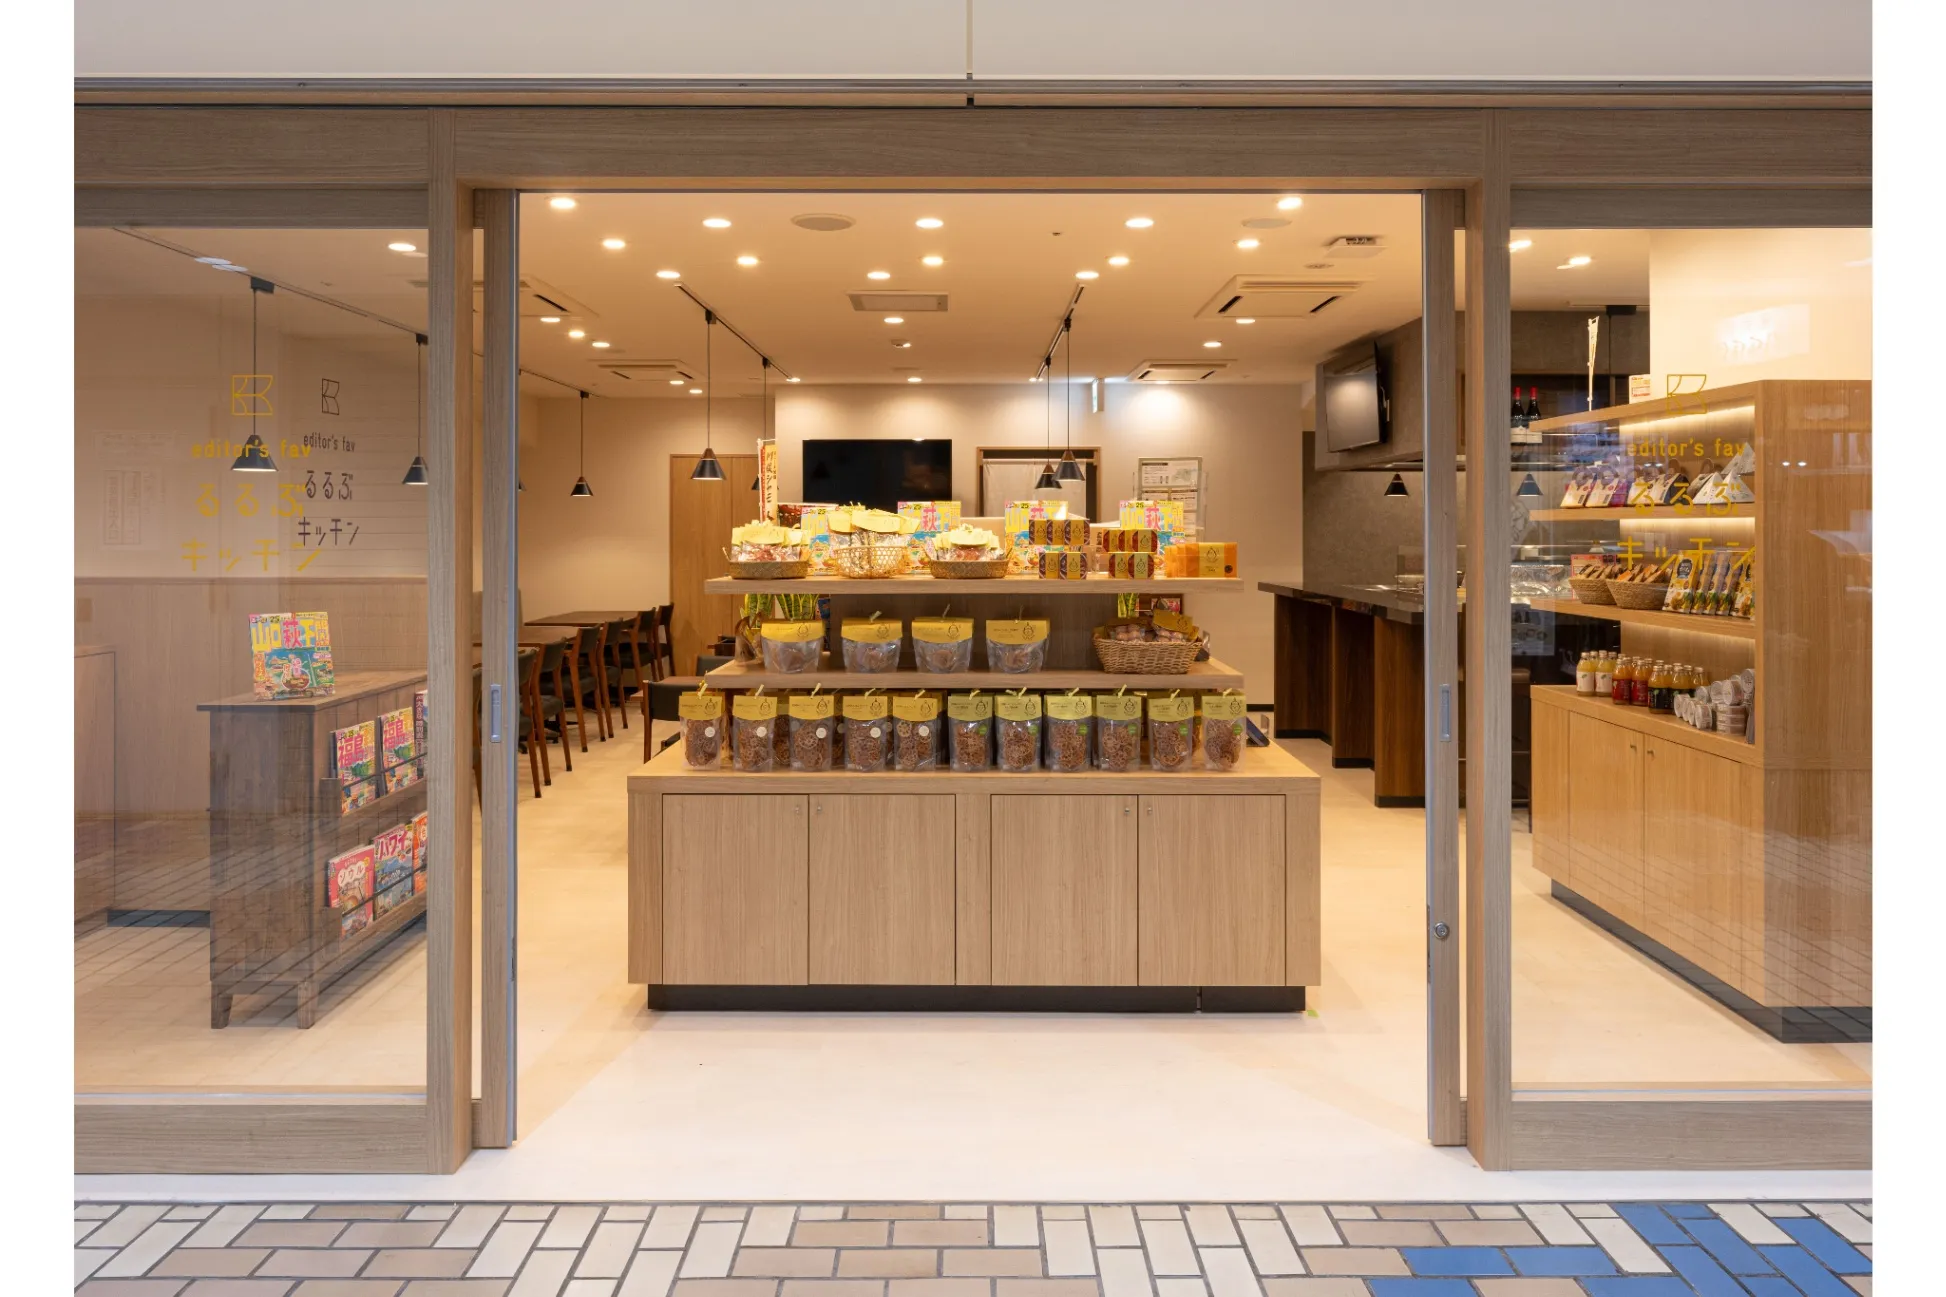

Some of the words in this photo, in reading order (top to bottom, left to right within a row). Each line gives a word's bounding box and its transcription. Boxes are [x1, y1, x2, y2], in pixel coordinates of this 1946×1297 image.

[191, 439, 270, 458] editor's
[281, 439, 311, 458] fav
[303, 431, 339, 451] editor's
[342, 436, 356, 452] fav
[1627, 438, 1704, 457] editor's
[1714, 438, 1747, 457] fav
[195, 483, 305, 517] るるぶ
[305, 470, 354, 500] るるぶ
[1630, 482, 1741, 516] るるぶ
[298, 517, 359, 546] キッチン
[181, 538, 321, 571] キッチン
[1617, 536, 1756, 570] キッチン
[338, 734, 365, 768] 福島
[379, 830, 409, 860] ハワイ
[339, 864, 364, 882] ソウル
